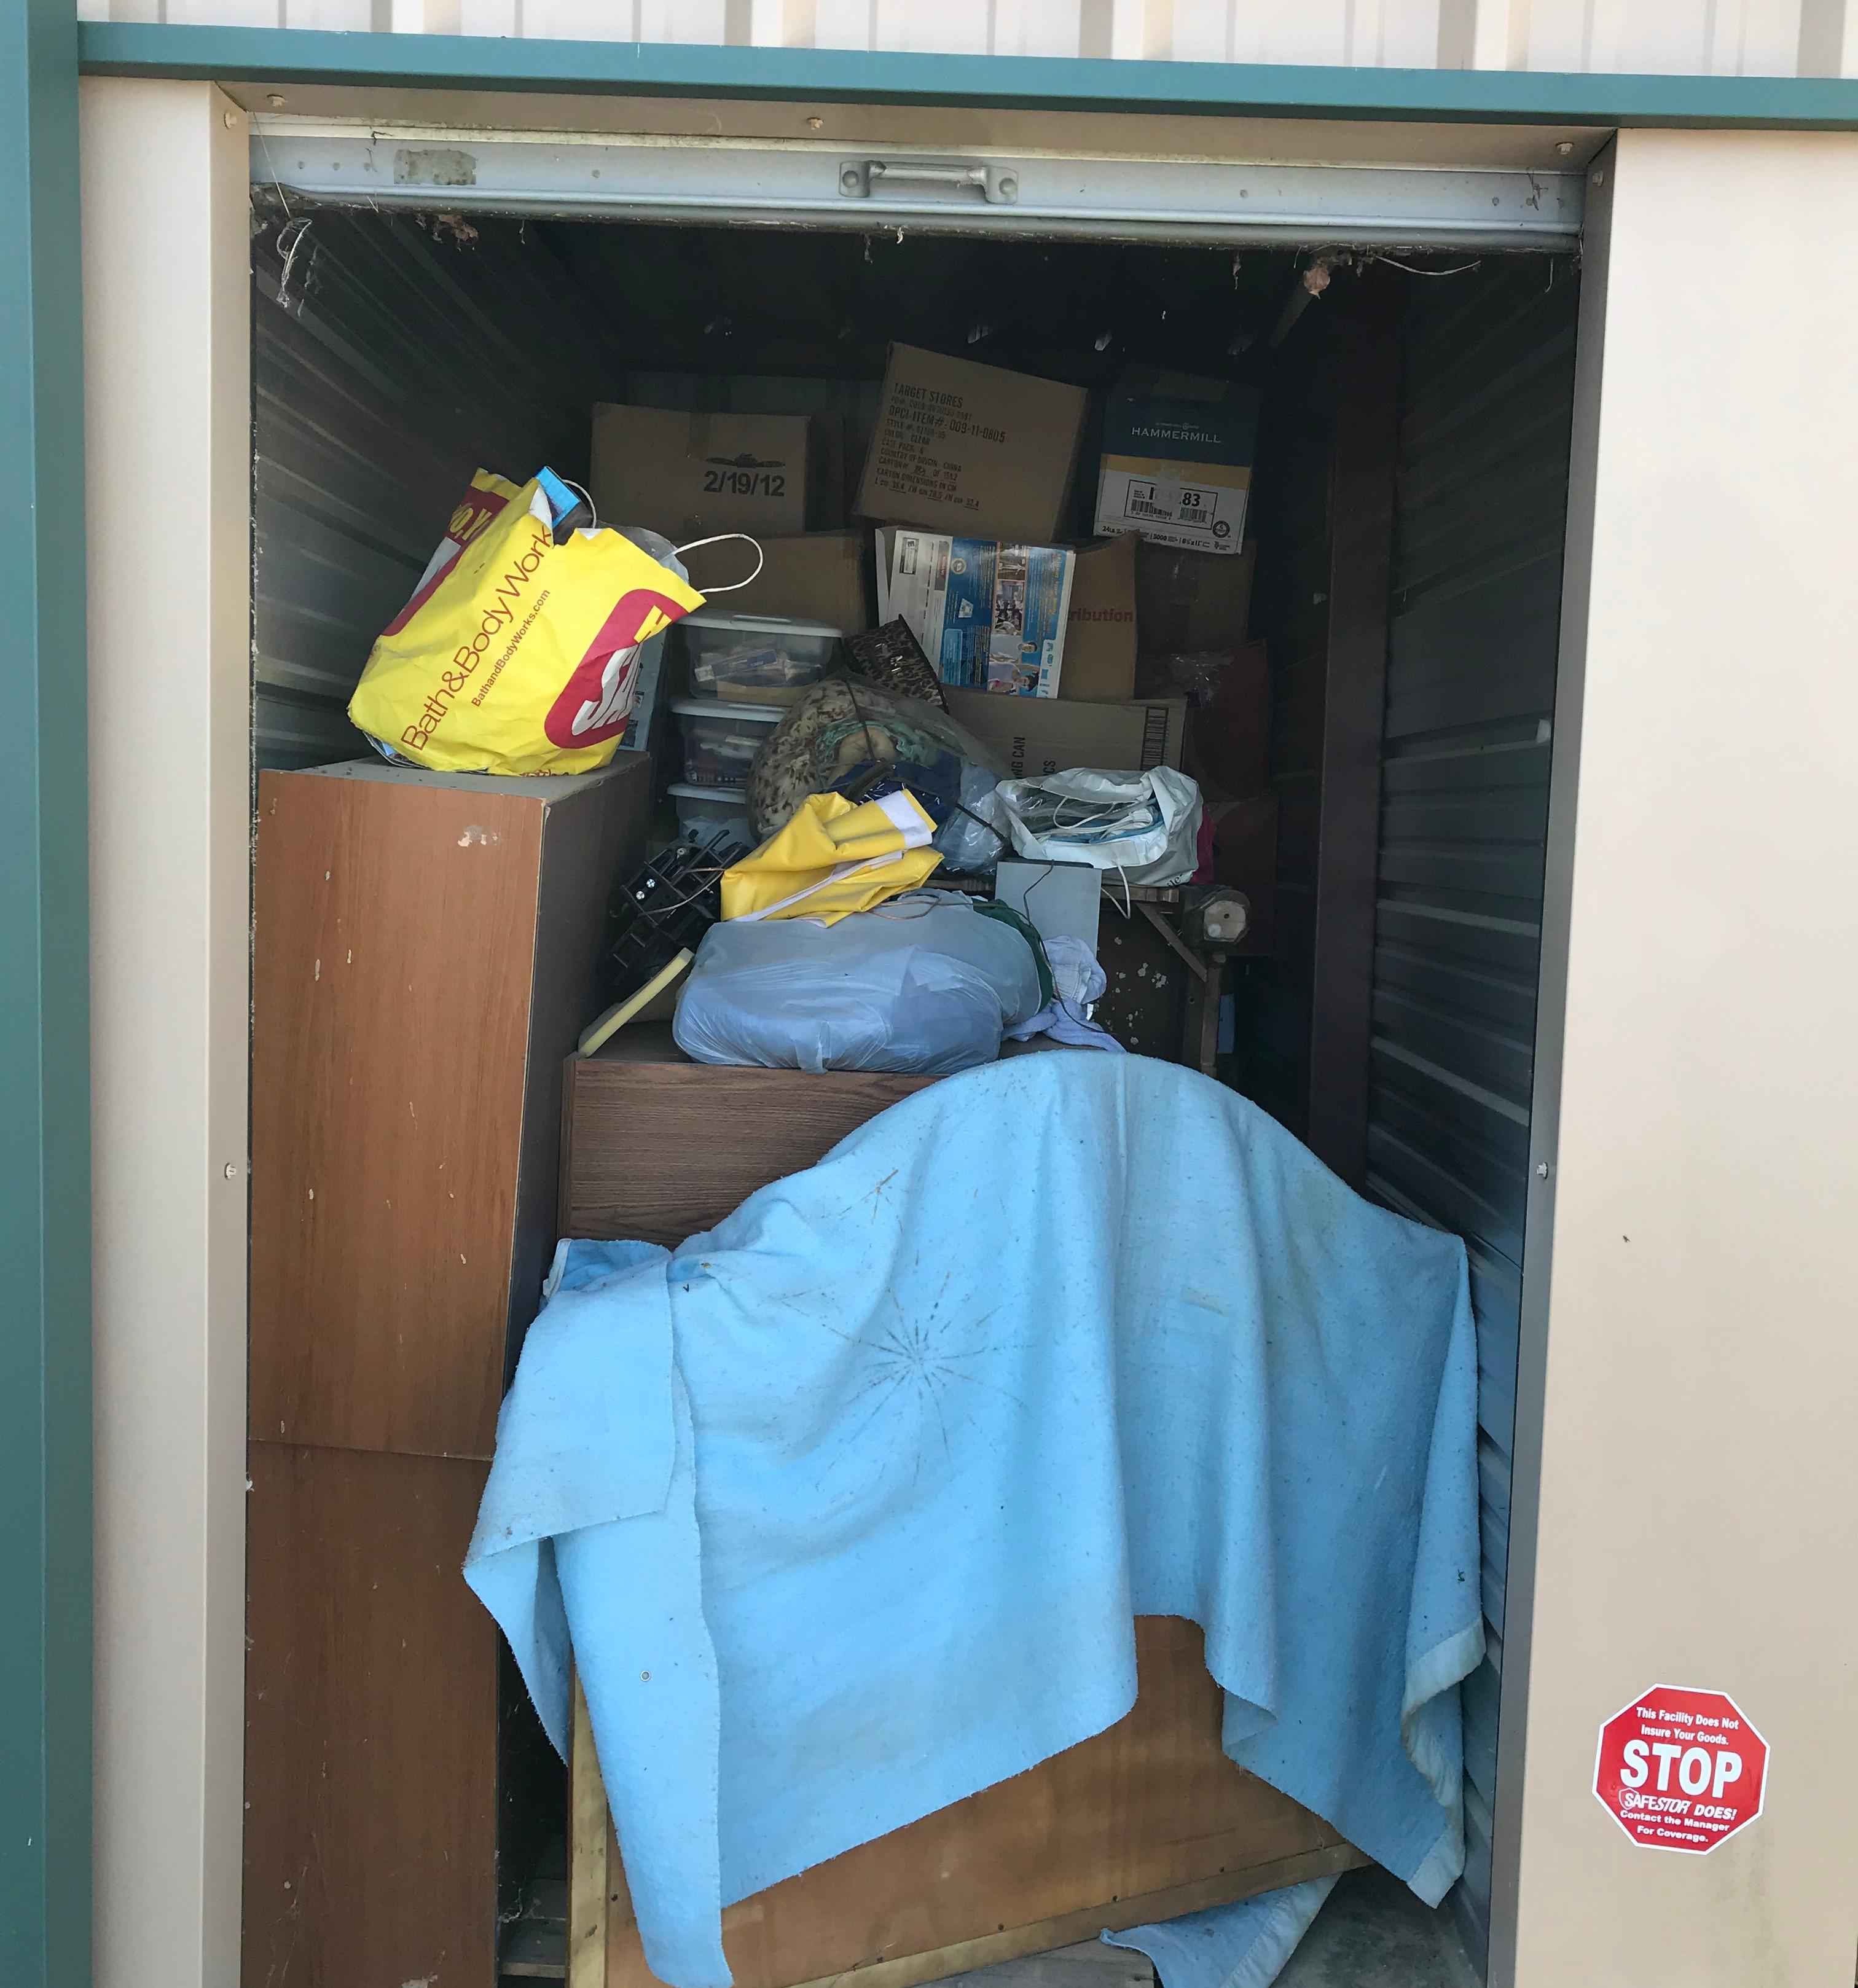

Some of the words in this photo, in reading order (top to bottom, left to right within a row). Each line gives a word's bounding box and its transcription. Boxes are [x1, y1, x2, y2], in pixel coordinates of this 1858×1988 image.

[893, 382, 927, 401] TARGET
[928, 391, 964, 409] STORES
[1132, 427, 1221, 443] HAMMERMILL
[704, 471, 785, 497] 2/19/12
[1068, 607, 1133, 622] ribution
[471, 589, 551, 706] BathandBodyWorks.com
[1012, 737, 1025, 757] CAN
[1043, 760, 1056, 776] CS
[1637, 1707, 1656, 1720] This
[1659, 1710, 1693, 1726] Facility
[1696, 1715, 1719, 1727] Does
[1722, 1718, 1739, 1729] Not
[1641, 1724, 1671, 1737] Insure
[1674, 1728, 1695, 1740] Your
[1697, 1731, 1729, 1745] Goods.
[1620, 1739, 1742, 1798] STOP
[1620, 1810, 1661, 1823] Contact
[1664, 1813, 1681, 1825] the
[1684, 1818, 1730, 1832] Manager
[1694, 1804, 1738, 1820] DOES!
[1637, 1825, 1655, 1835] For
[1656, 1828, 1709, 1843] Coverage.
